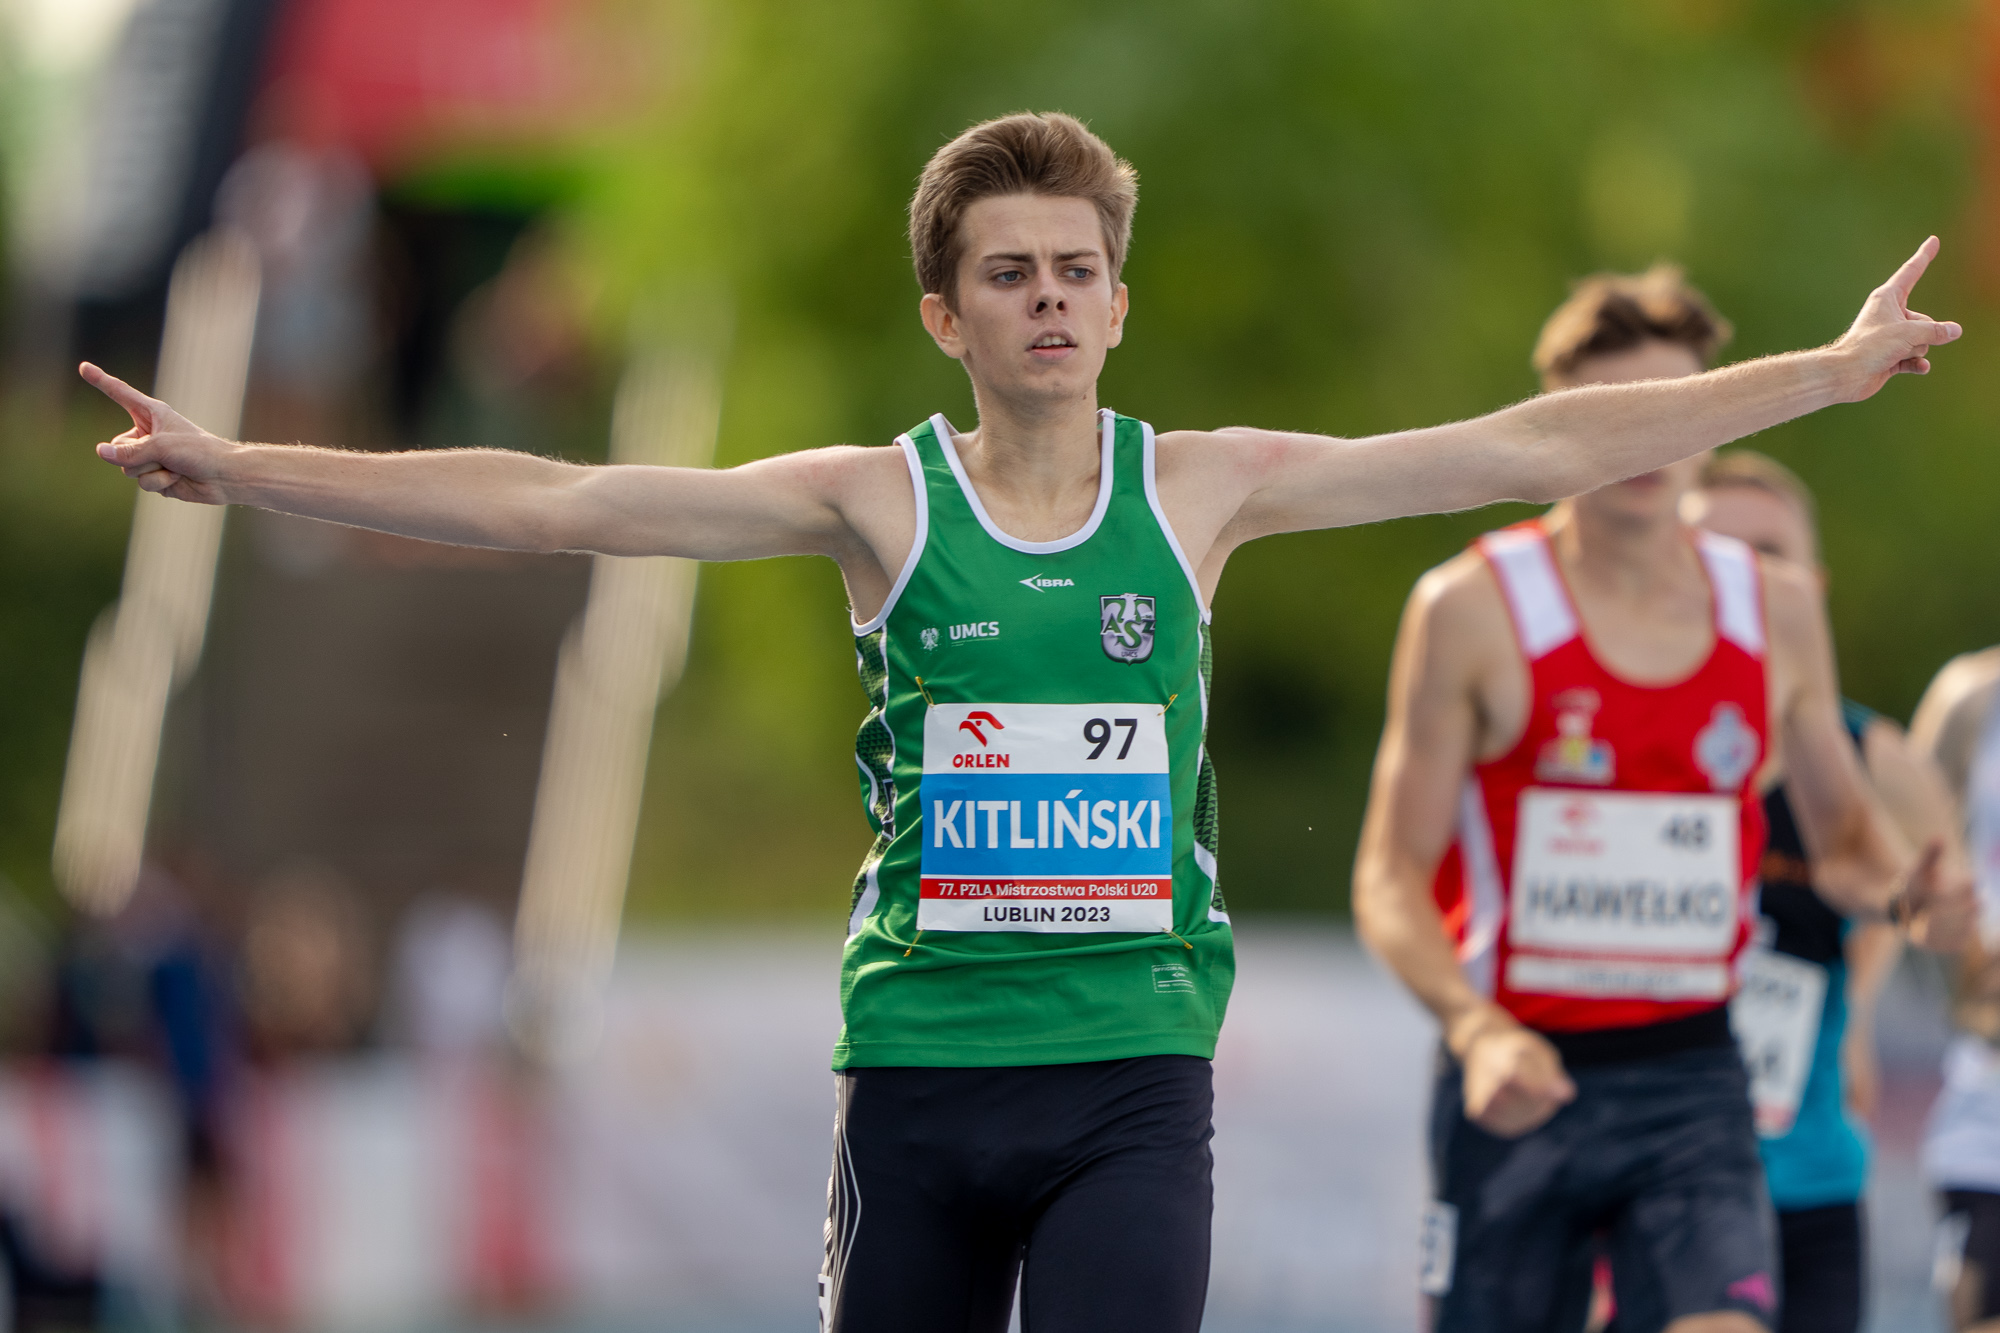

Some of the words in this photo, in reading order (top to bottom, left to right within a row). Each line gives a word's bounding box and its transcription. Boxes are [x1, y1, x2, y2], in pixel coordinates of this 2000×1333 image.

[949, 620, 1000, 641] UMCS
[1082, 717, 1139, 761] 97
[952, 753, 1010, 768] ORLEN
[933, 788, 1161, 850] KITLIŃSKI
[1662, 814, 1711, 852] 48
[938, 882, 958, 897] 77.
[960, 883, 992, 897] PZLA
[995, 883, 1086, 897] Mistrzostwa
[1088, 883, 1128, 897] Polski
[1130, 883, 1159, 897] U20
[983, 906, 1056, 923] LUBLIN
[1060, 906, 1111, 923] 2023
